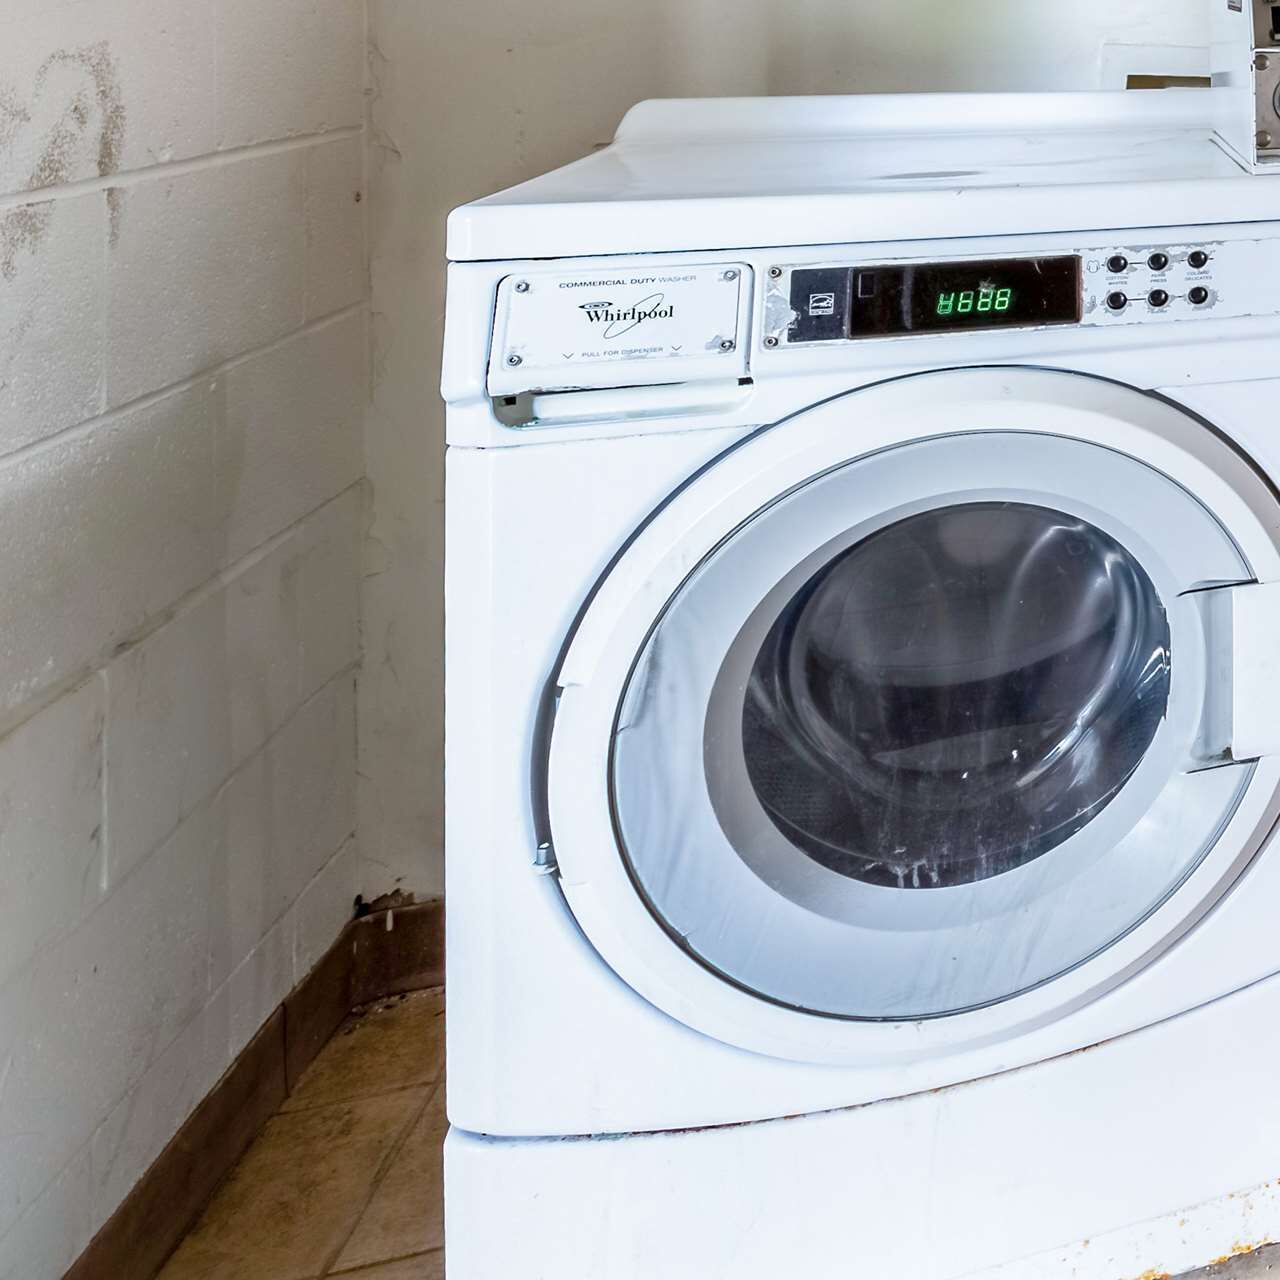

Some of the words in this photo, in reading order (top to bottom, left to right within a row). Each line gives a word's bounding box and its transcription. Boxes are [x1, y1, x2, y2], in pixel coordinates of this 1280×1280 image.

[558, 279, 627, 289] COMMERCIAL
[630, 277, 656, 285] DUTY
[658, 275, 697, 283] WASHER
[586, 305, 674, 323] Whirlpool
[621, 347, 664, 355] DISPENSER
